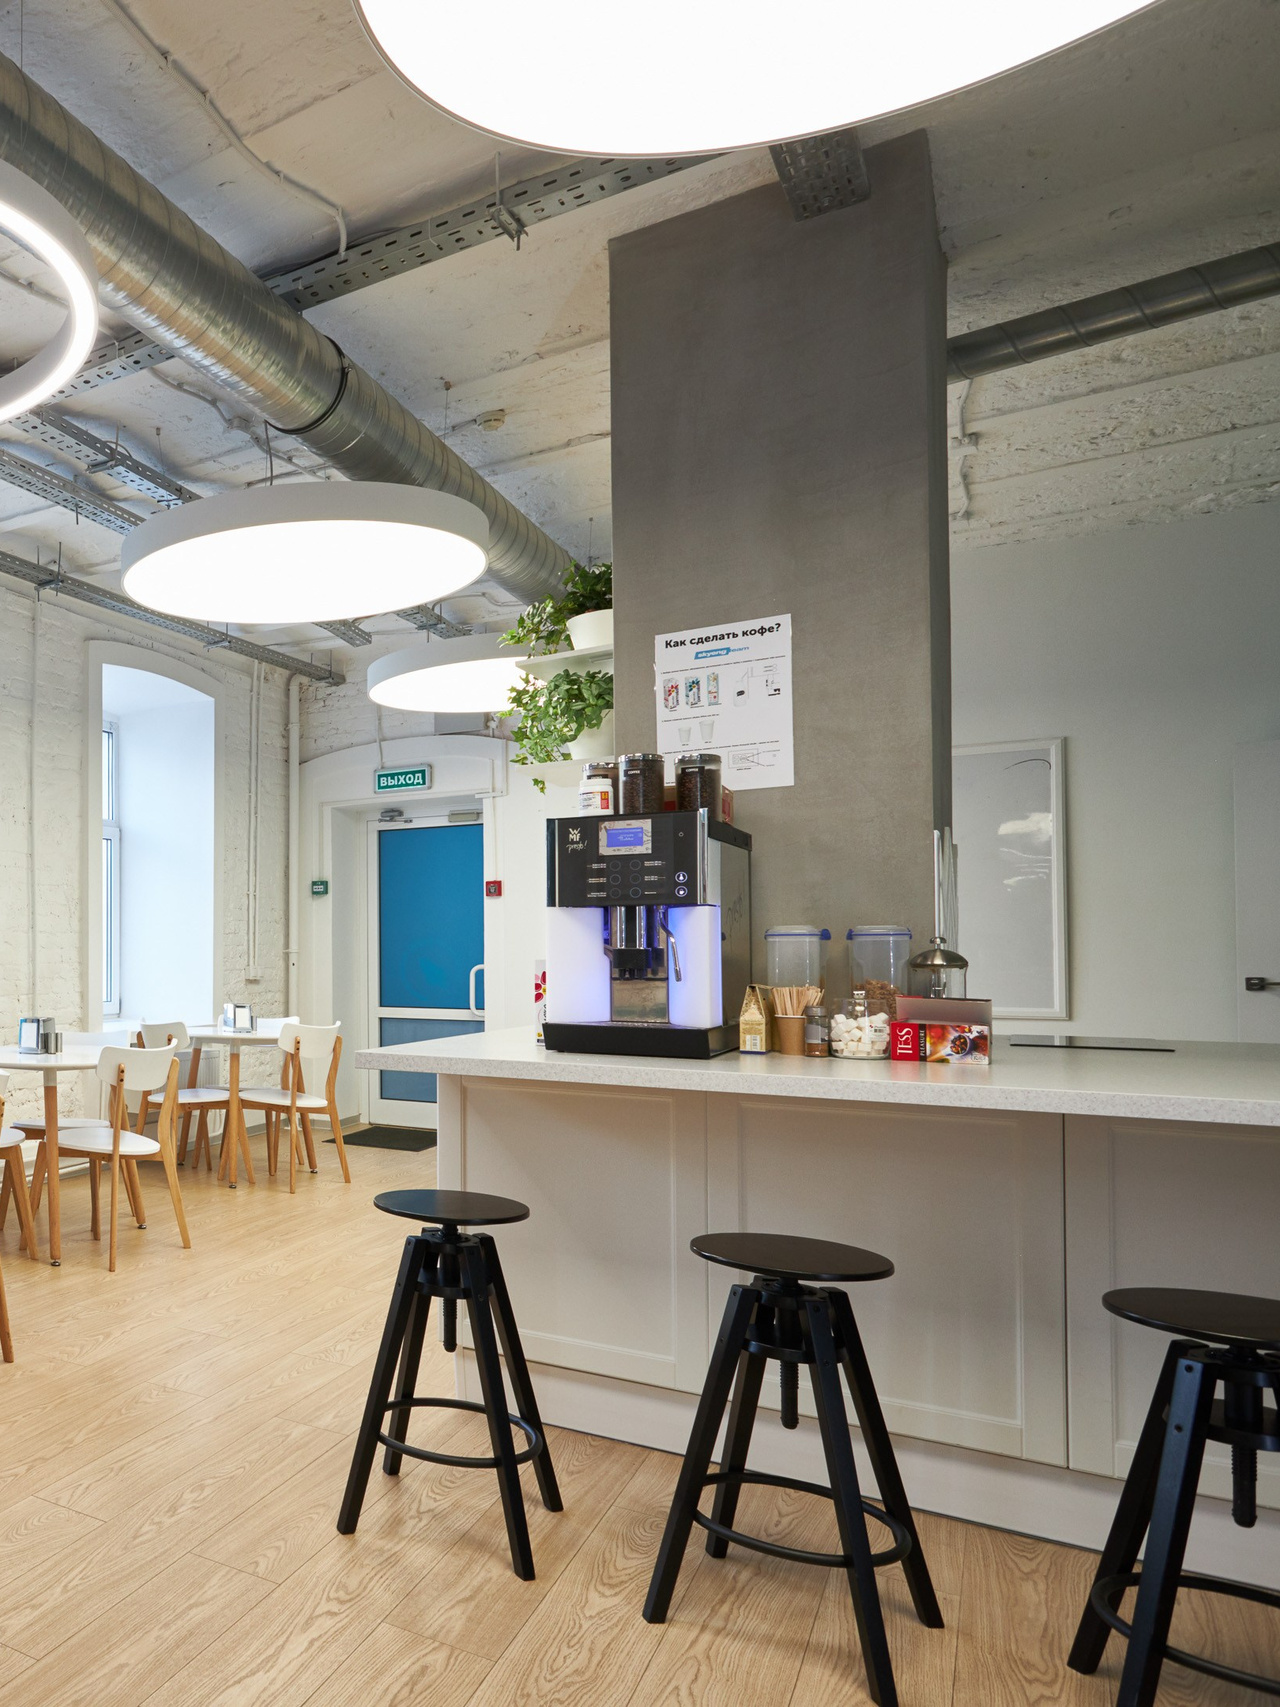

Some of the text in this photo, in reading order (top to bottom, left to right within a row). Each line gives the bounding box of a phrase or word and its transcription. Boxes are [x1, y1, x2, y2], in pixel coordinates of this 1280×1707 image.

[665, 622, 782, 649] Как сделать кофе?
[380, 773, 423, 787] ВЫХОД
[896, 1027, 913, 1056] TESS
